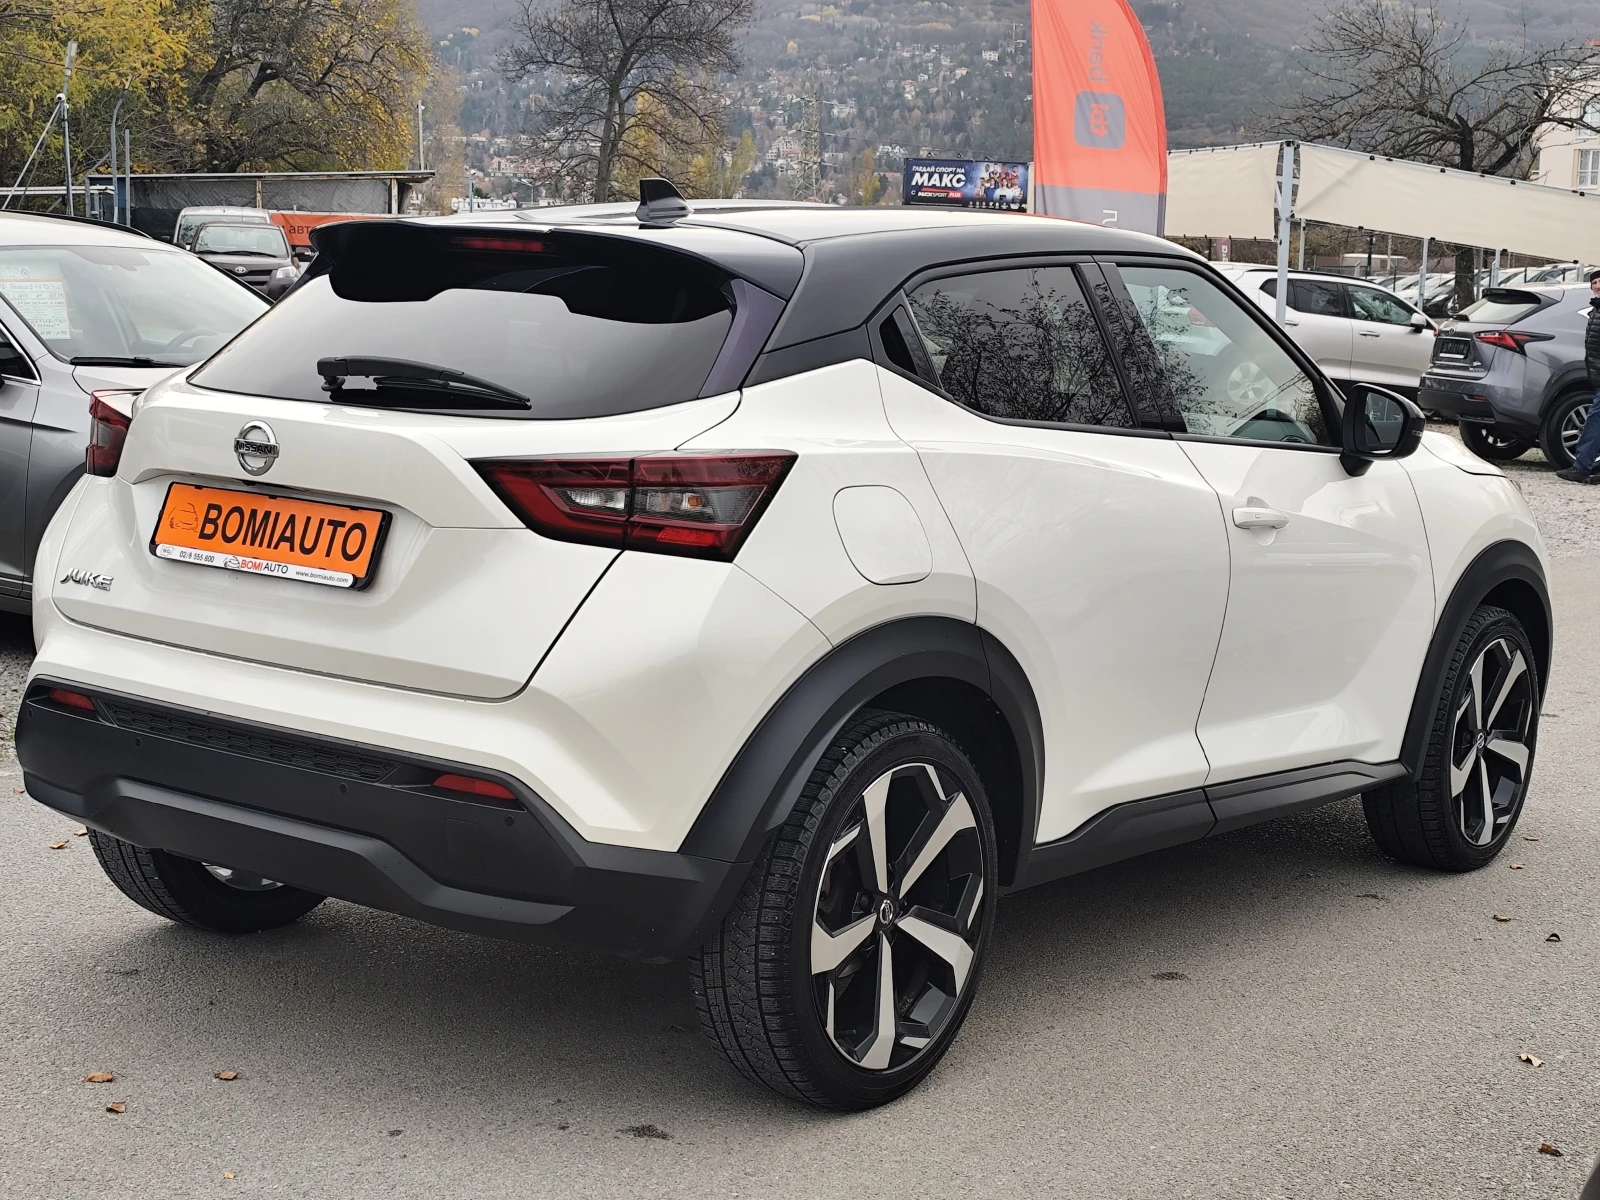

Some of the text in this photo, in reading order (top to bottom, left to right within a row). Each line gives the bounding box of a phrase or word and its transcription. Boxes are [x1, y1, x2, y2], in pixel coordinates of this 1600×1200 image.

[912, 165, 935, 173] ГЛЕДАЙ
[911, 172, 966, 188] МАКС
[288, 224, 314, 235] авт
[235, 439, 272, 455] NISSAN
[198, 502, 367, 562] BOMIAUTO
[193, 552, 204, 561] 555
[204, 554, 215, 563] 800
[60, 567, 114, 591] JUKE
[295, 570, 349, 583] www.bomiauto.com
